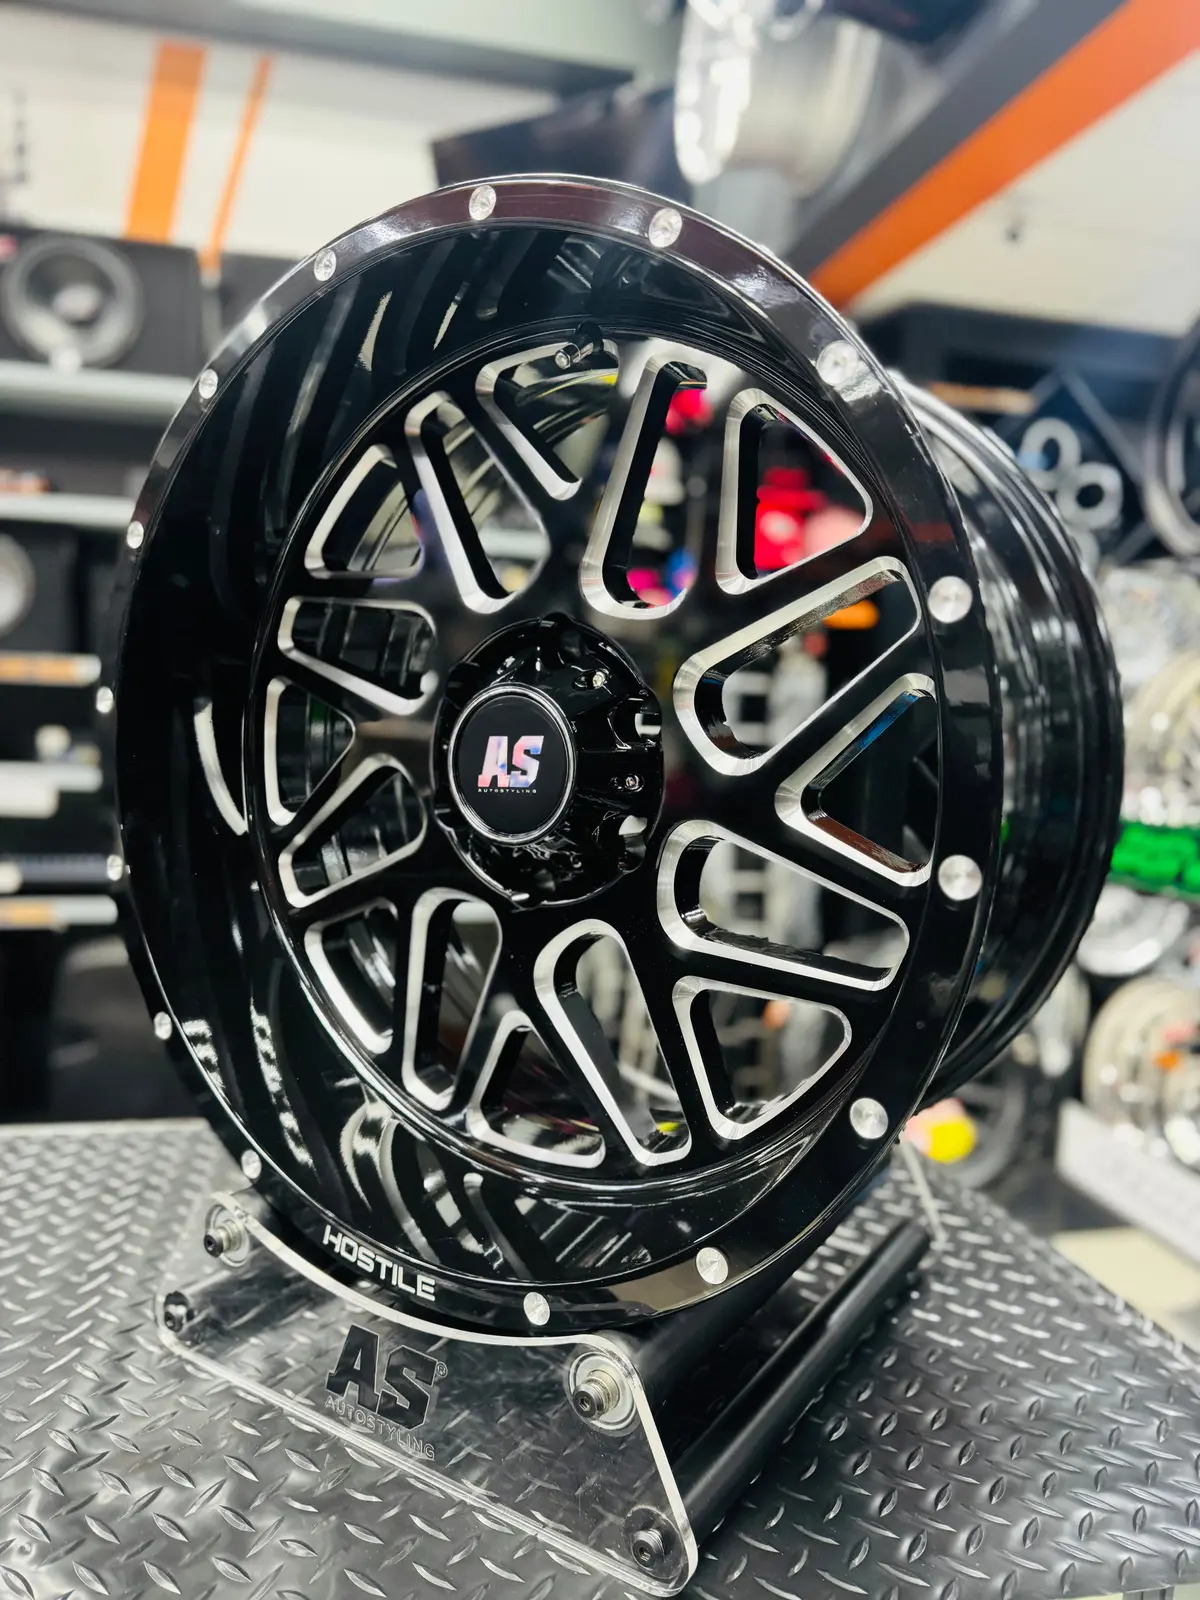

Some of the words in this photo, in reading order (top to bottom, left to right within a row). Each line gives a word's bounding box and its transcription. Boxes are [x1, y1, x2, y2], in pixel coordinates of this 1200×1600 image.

[477, 735, 544, 788] AS
[322, 1224, 436, 1301] HOSTILE
[325, 1395, 435, 1460] AUTOSTYLING
